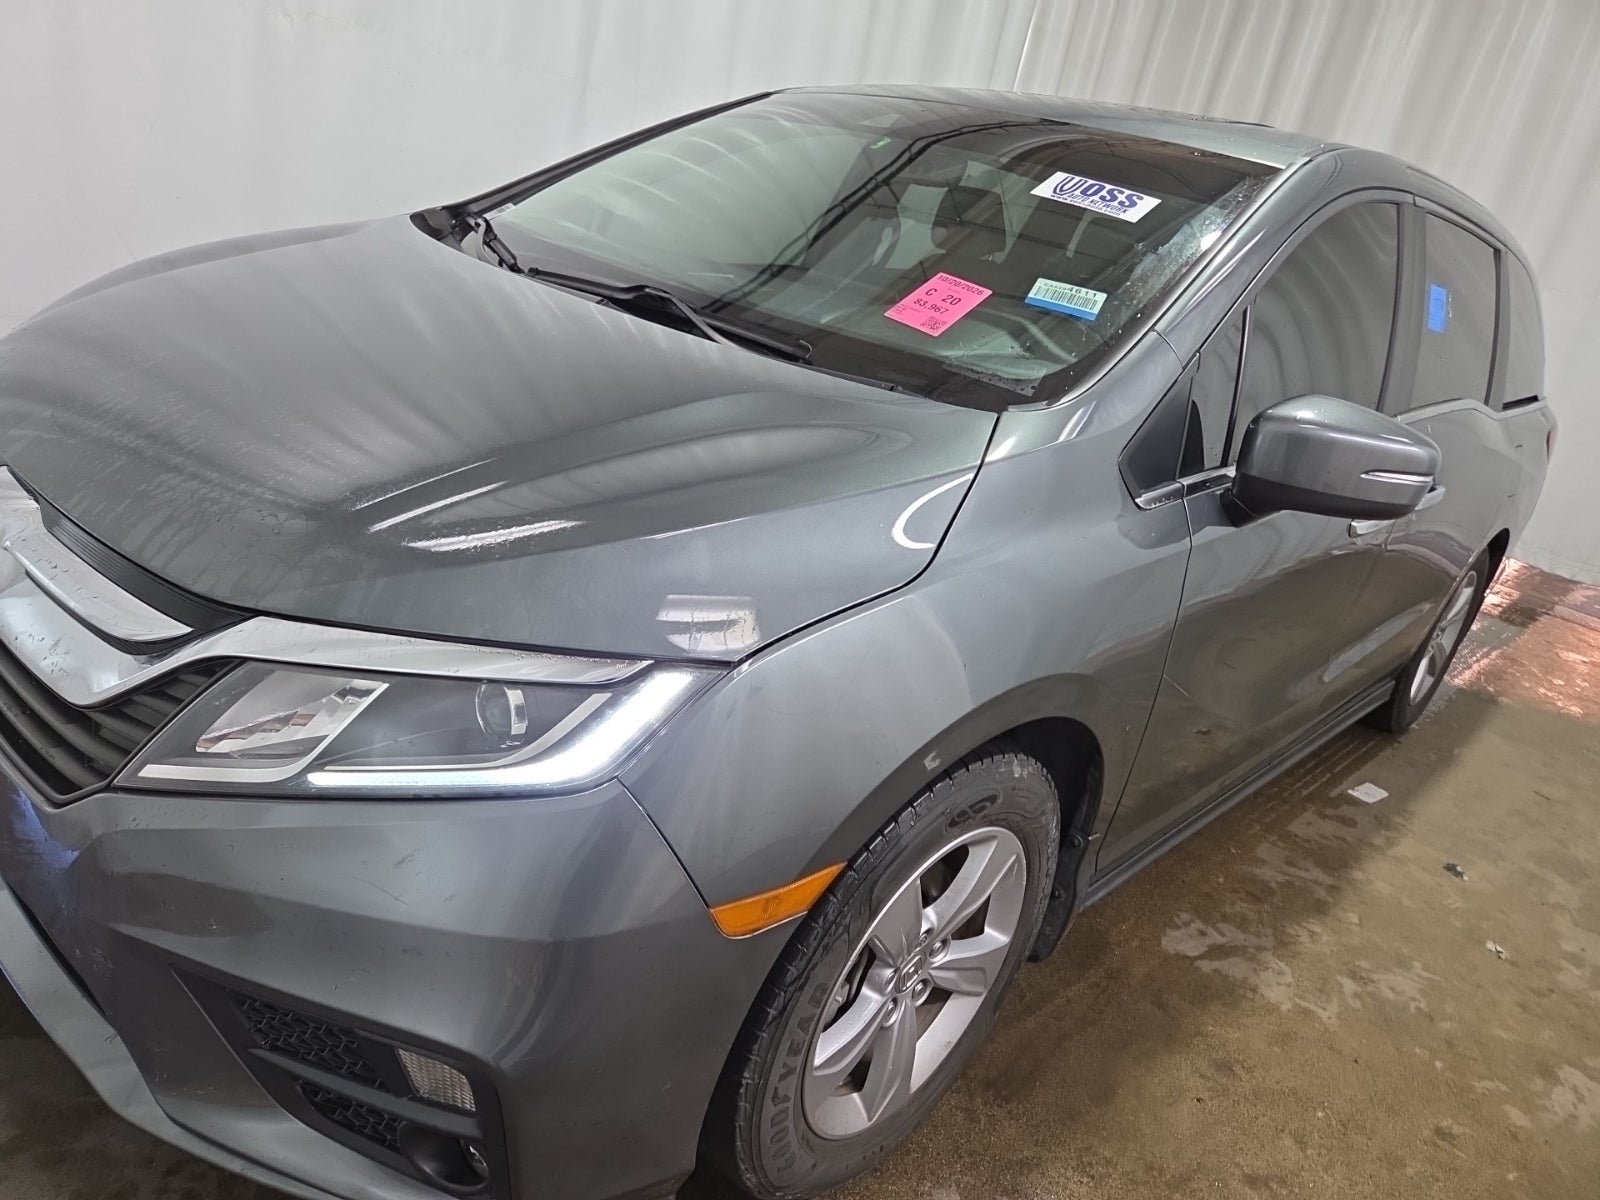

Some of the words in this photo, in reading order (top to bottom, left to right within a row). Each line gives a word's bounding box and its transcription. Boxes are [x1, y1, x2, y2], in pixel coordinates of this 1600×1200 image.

[1052, 175, 1144, 209] VOSS
[1066, 193, 1091, 203] AUTO
[1089, 199, 1130, 214] NETWORK
[925, 288, 938, 297] C
[942, 294, 962, 306] 20
[770, 982, 832, 1174] GOODYEAR
